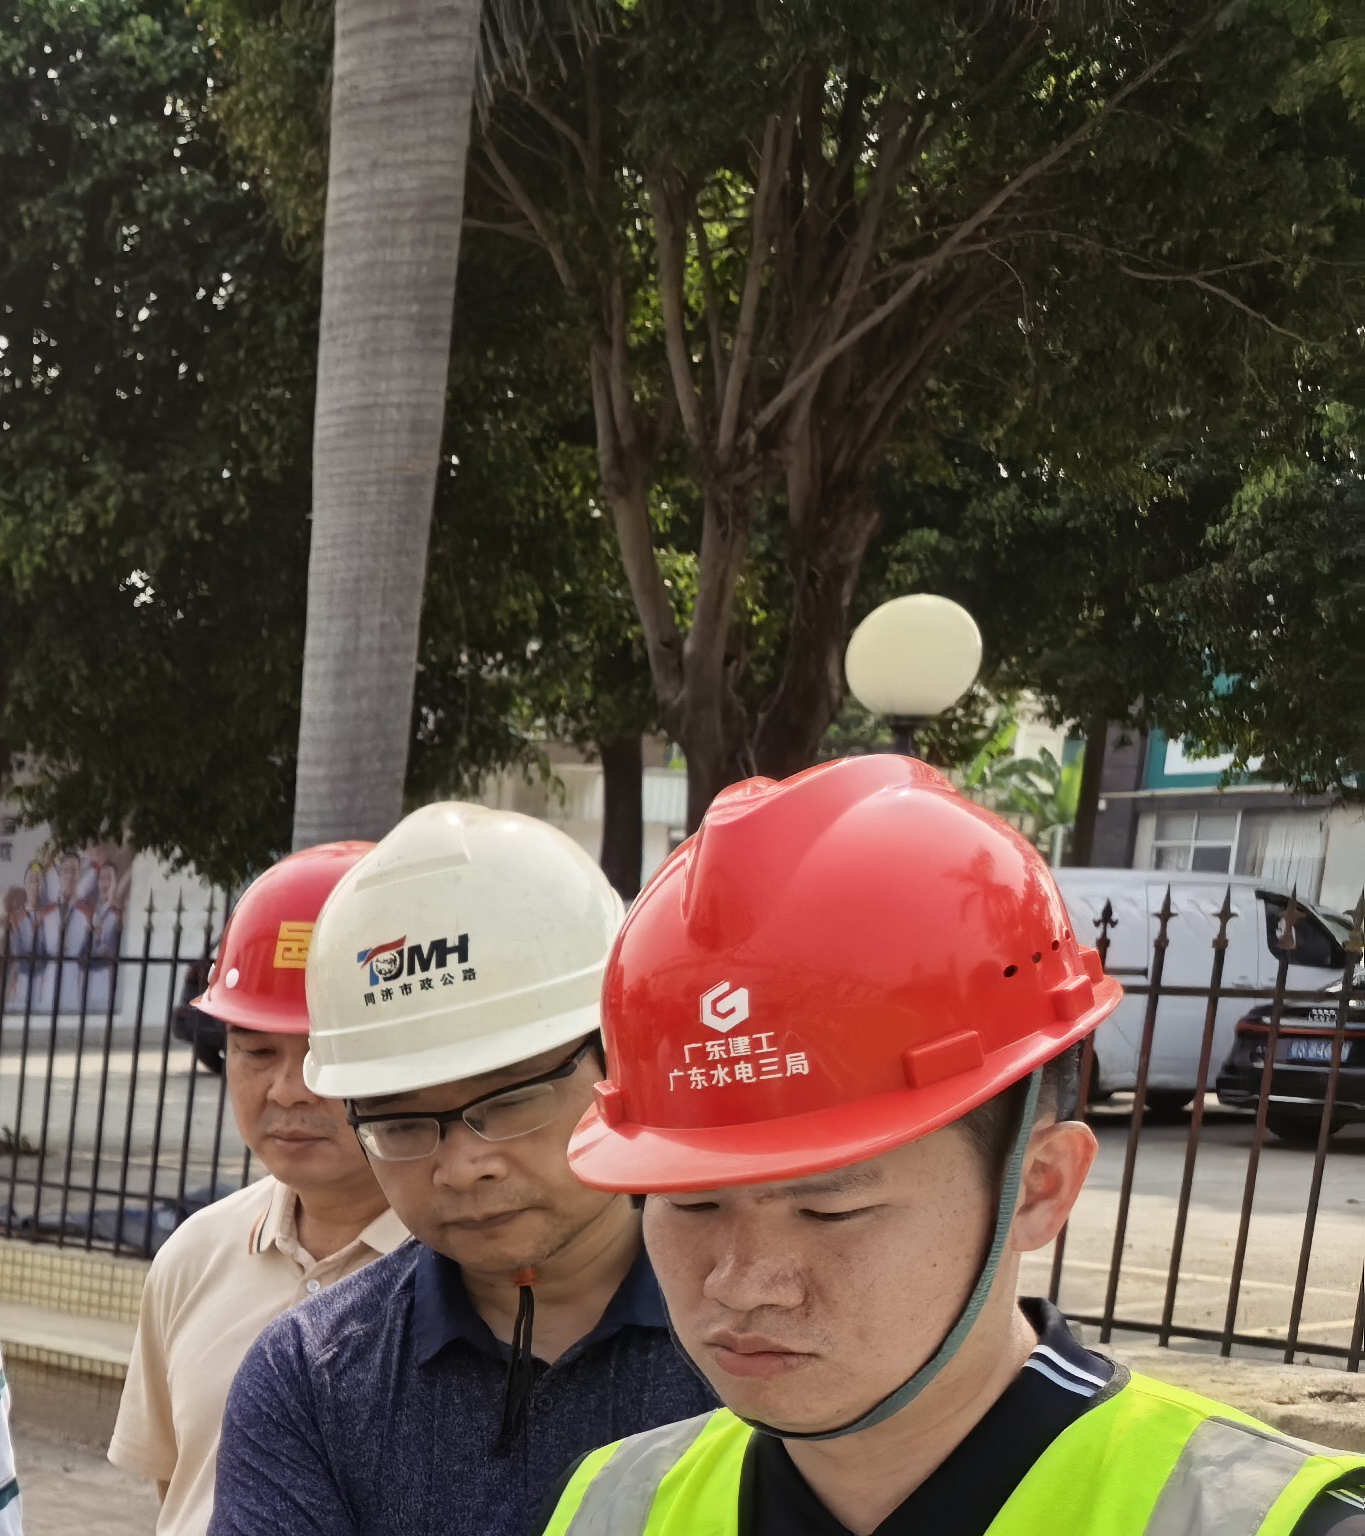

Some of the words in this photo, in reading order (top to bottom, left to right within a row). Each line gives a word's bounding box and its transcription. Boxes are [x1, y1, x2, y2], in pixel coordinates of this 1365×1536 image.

[364, 967, 477, 1007] 同济市政公路
[683, 1031, 779, 1064] 广东建工
[668, 1051, 810, 1092] 广东水电三局
